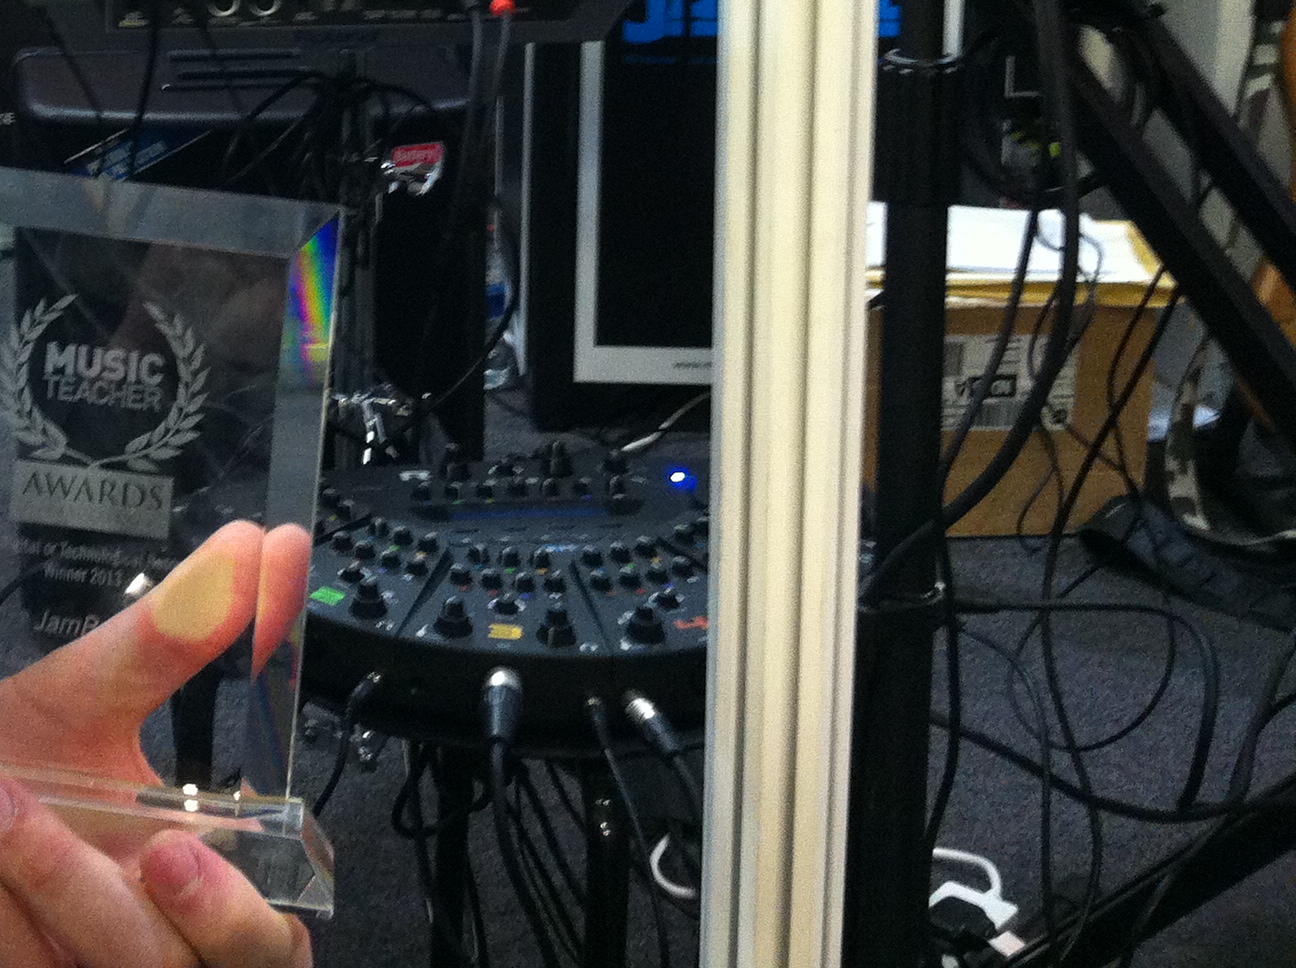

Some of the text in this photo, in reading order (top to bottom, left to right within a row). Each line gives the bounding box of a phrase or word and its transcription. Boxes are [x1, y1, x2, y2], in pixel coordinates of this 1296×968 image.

[44, 340, 167, 385] MUSIC
[43, 373, 163, 413] TEACHER
[21, 471, 164, 512] AWARDS
